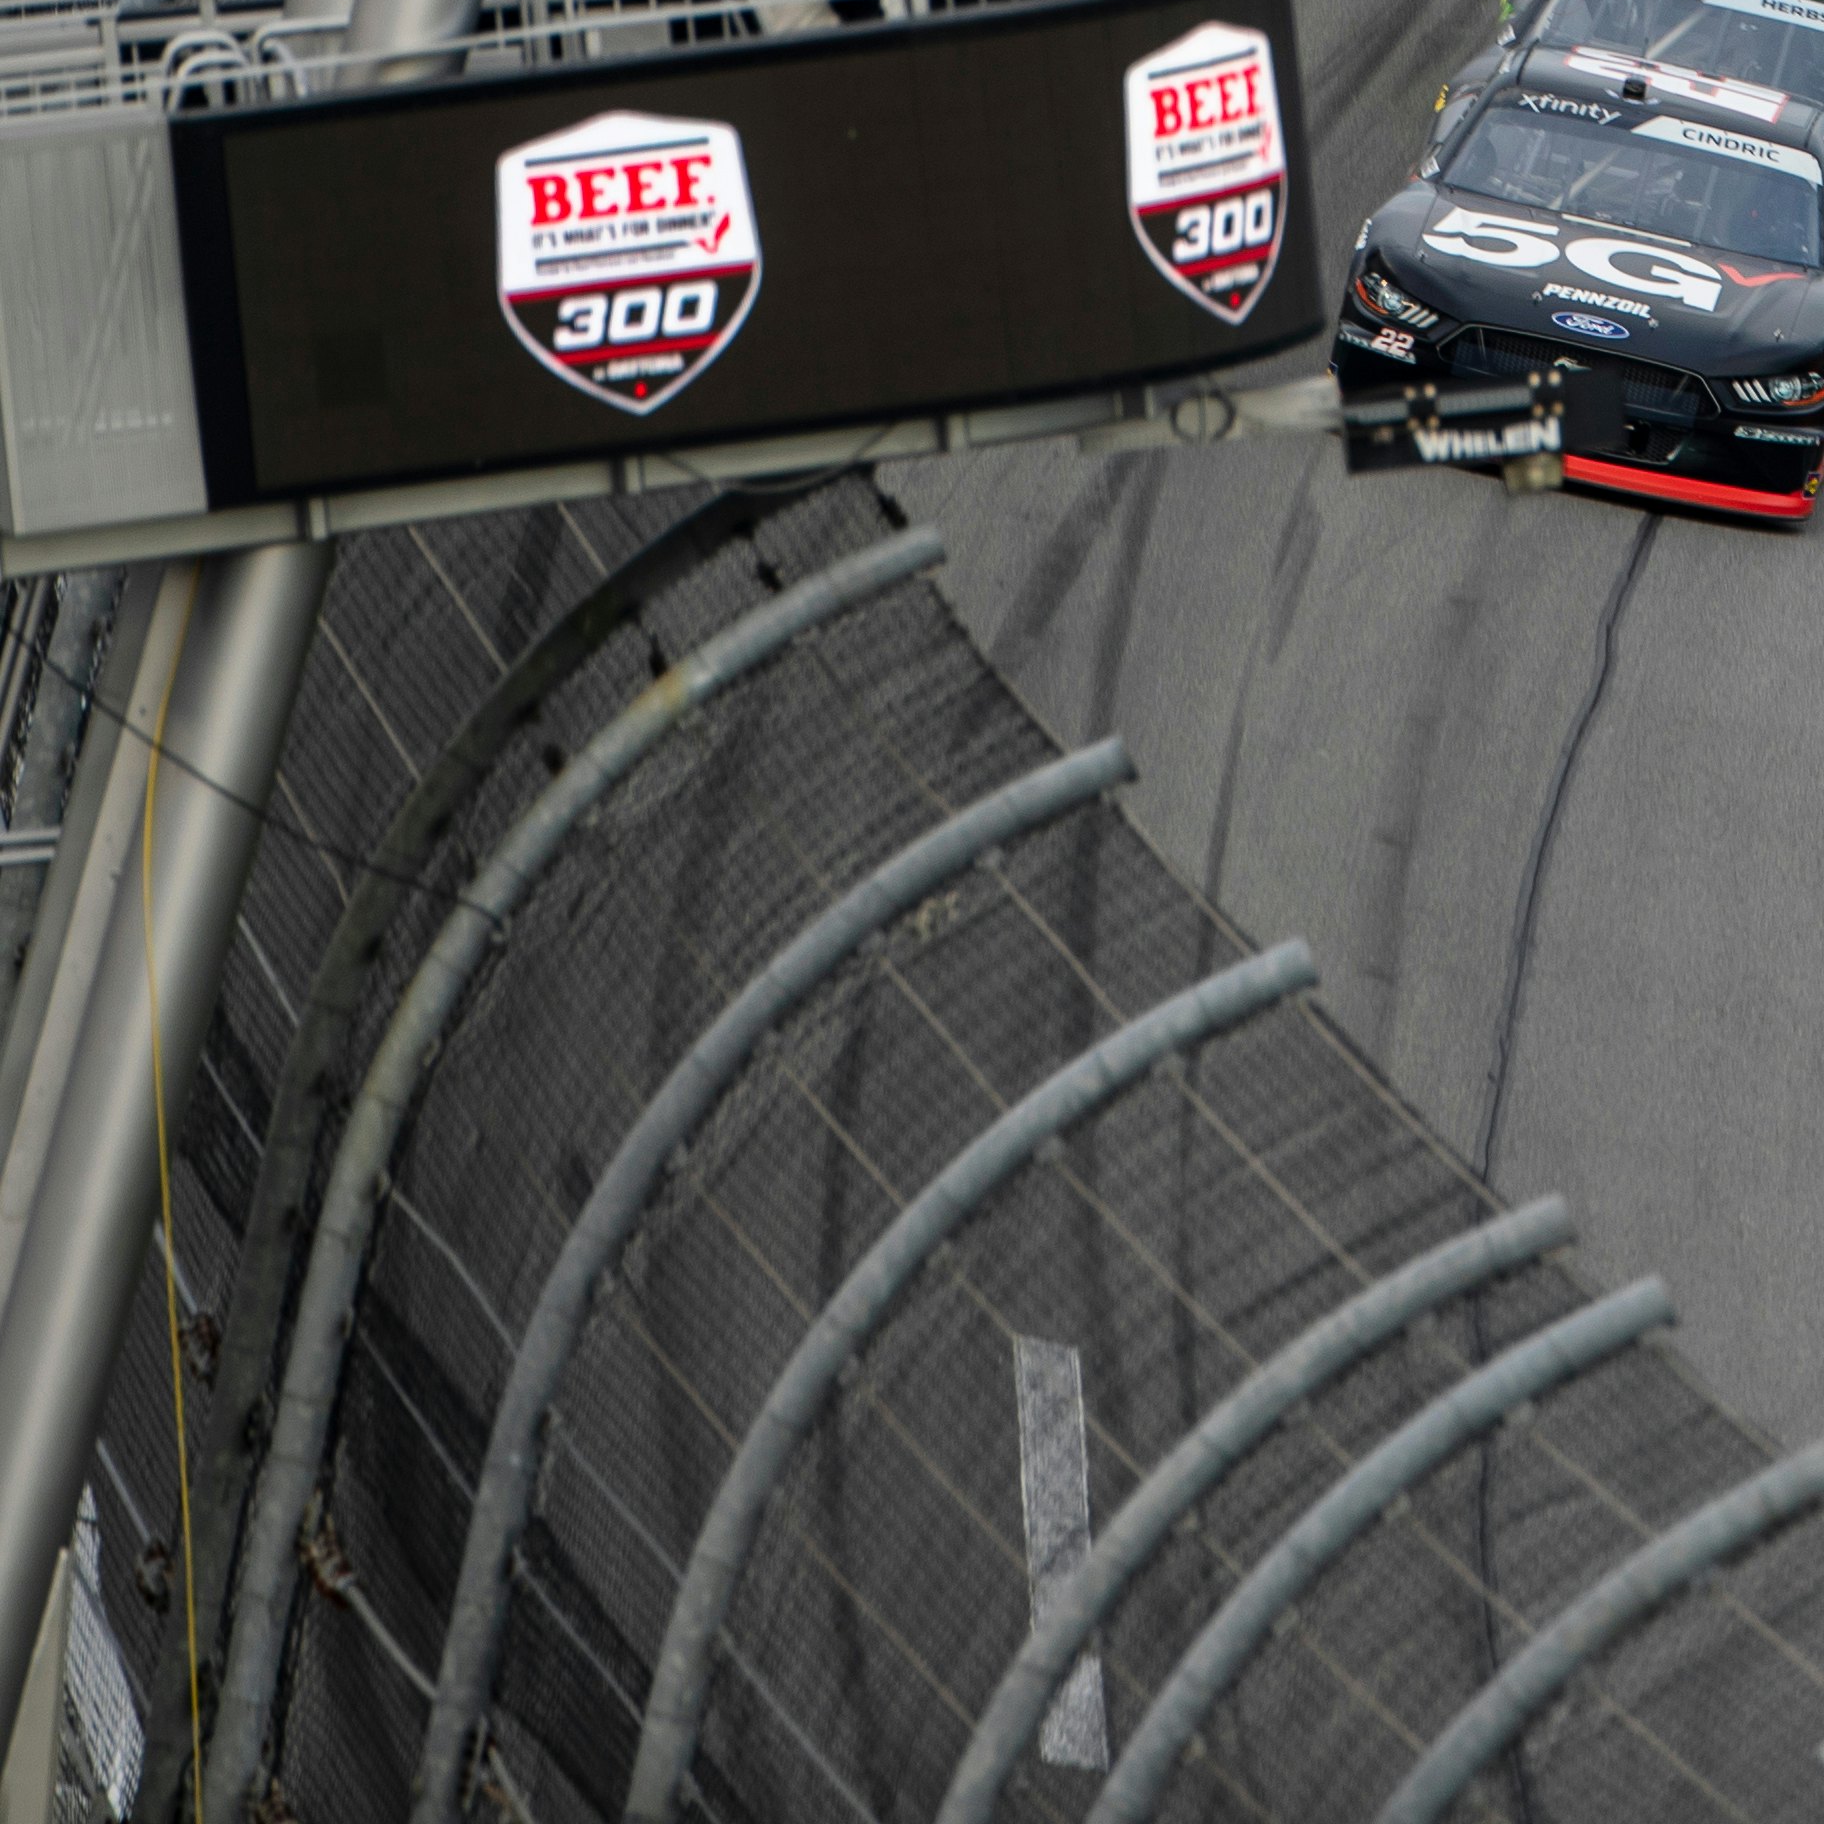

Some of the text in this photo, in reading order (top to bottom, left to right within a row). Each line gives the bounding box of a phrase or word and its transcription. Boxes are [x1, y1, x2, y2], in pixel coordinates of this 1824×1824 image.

[1517, 92, 1622, 125] xfinity
[1681, 126, 1782, 164] CINDRIC
[622, 220, 649, 238] FOR
[1173, 187, 1274, 265] 300
[1421, 206, 1724, 313] 5G
[554, 279, 718, 351] 300
[1540, 281, 1653, 321] PENNZOIL
[1370, 327, 1415, 358] 22
[1412, 414, 1562, 463] WHELEN
